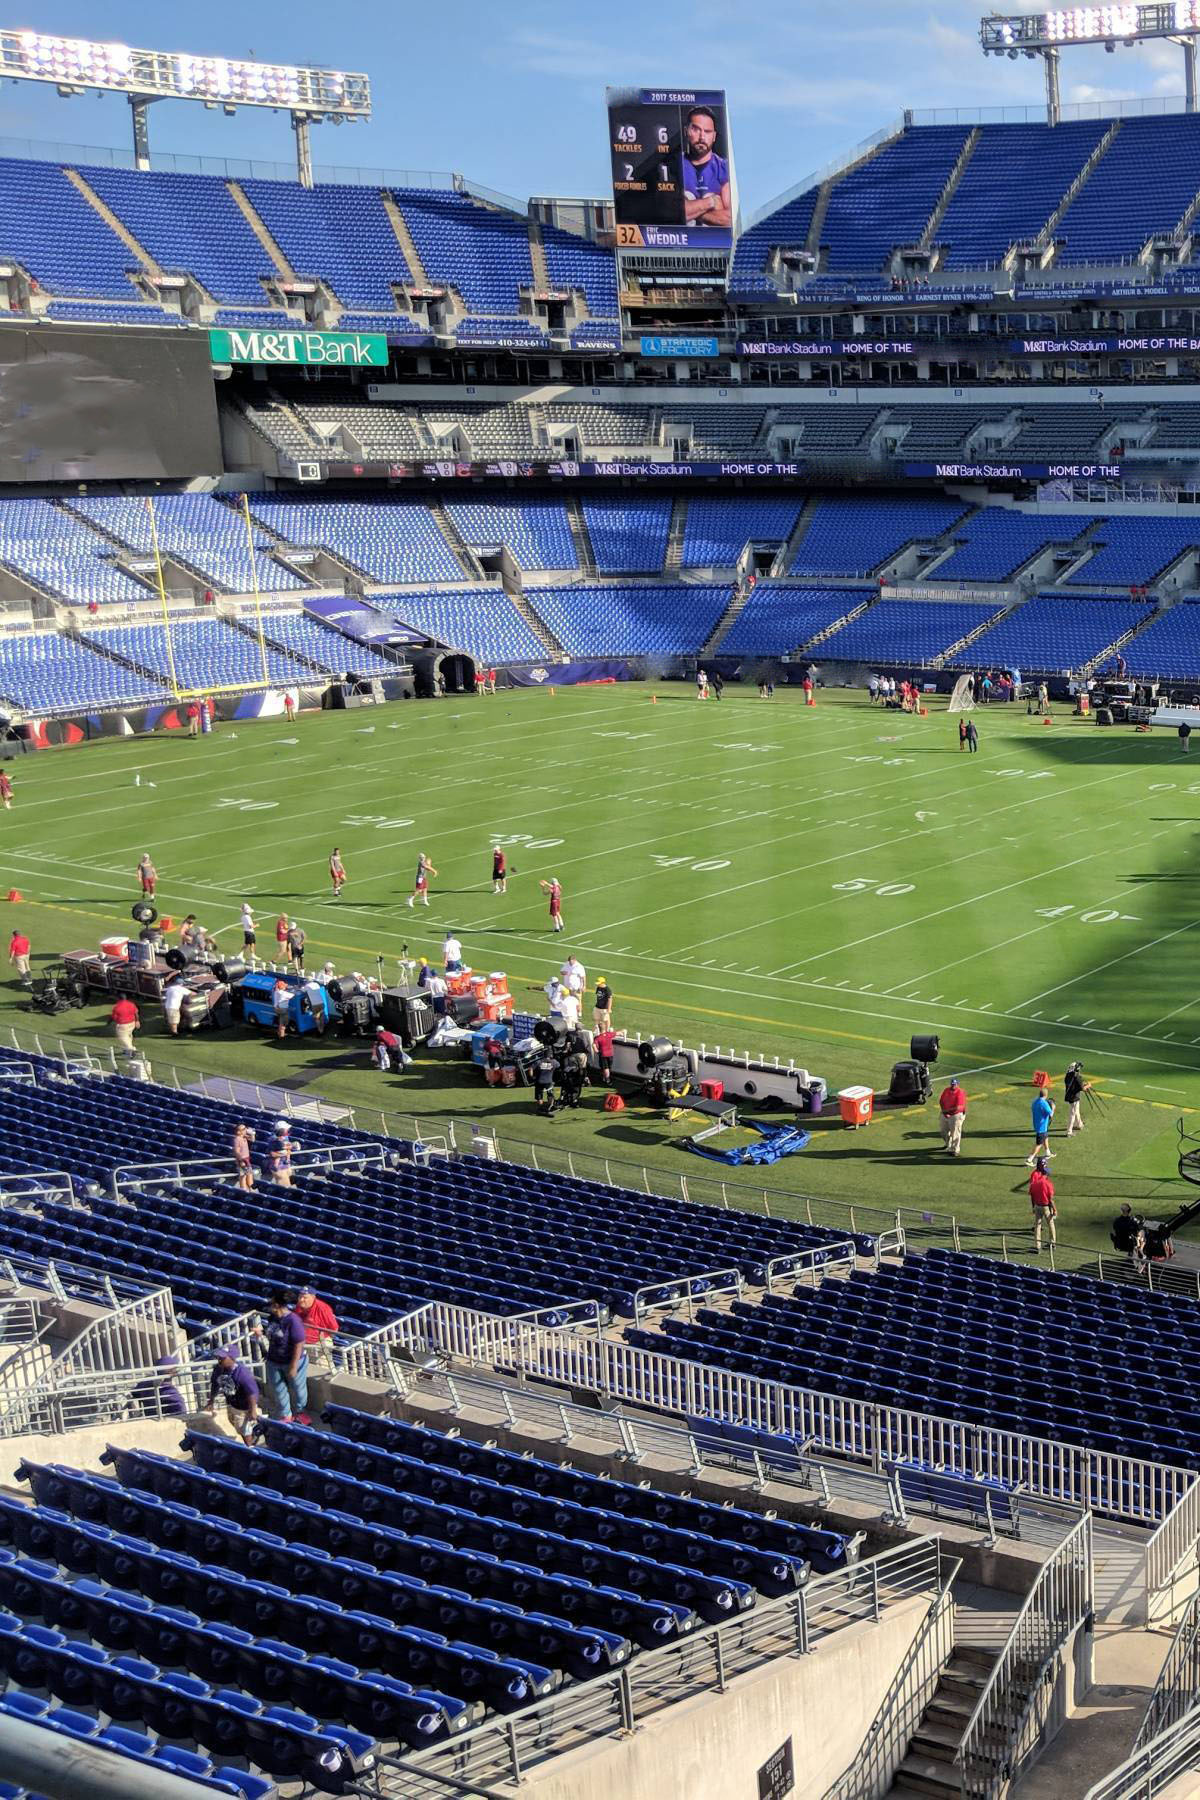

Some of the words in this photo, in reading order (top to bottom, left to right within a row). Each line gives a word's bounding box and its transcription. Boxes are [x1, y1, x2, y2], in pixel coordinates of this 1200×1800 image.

[652, 94, 667, 102] 2017
[669, 94, 695, 102] SEASON
[618, 126, 637, 143] 49
[658, 127, 668, 143] 6
[613, 144, 642, 152] TACKLES
[625, 164, 634, 181] 2
[661, 165, 668, 182] 1
[657, 182, 675, 192] SACK
[620, 227, 637, 244] 32
[646, 234, 688, 246] WEDDLE
[1112, 288, 1136, 296] ARTHUR
[228, 331, 302, 362] M&T
[305, 334, 373, 364] Bank
[660, 338, 712, 347] STRATEGIC
[743, 342, 767, 354] M&T
[768, 343, 791, 354] Bank
[792, 343, 832, 354] Stadium
[842, 344, 872, 353] HOME
[874, 344, 891, 353] OF
[892, 344, 912, 353] THE
[1024, 341, 1047, 352] M&T
[1048, 341, 1070, 352] Bank
[1070, 340, 1106, 351] Stadium
[1118, 339, 1148, 349] HOME
[1150, 339, 1165, 348] OF
[1167, 338, 1188, 348] THE
[661, 346, 712, 355] FACTORY
[595, 464, 622, 474] M&T
[622, 464, 648, 474] Bank
[650, 464, 692, 475] Stadium
[722, 464, 754, 474] HOME
[758, 464, 774, 475] OF
[776, 464, 798, 475] THE
[936, 465, 958, 476] M&T
[960, 465, 982, 476] Bank
[983, 465, 1022, 477] Stadium
[1048, 466, 1080, 476] HOME
[1082, 466, 1098, 476] OF
[1100, 466, 1120, 476] THE
[652, 854, 732, 872] 40
[832, 878, 916, 896] 50
[1034, 904, 1122, 924] 40
[859, 1102, 870, 1114] G
[771, 1762, 782, 1785] 151
